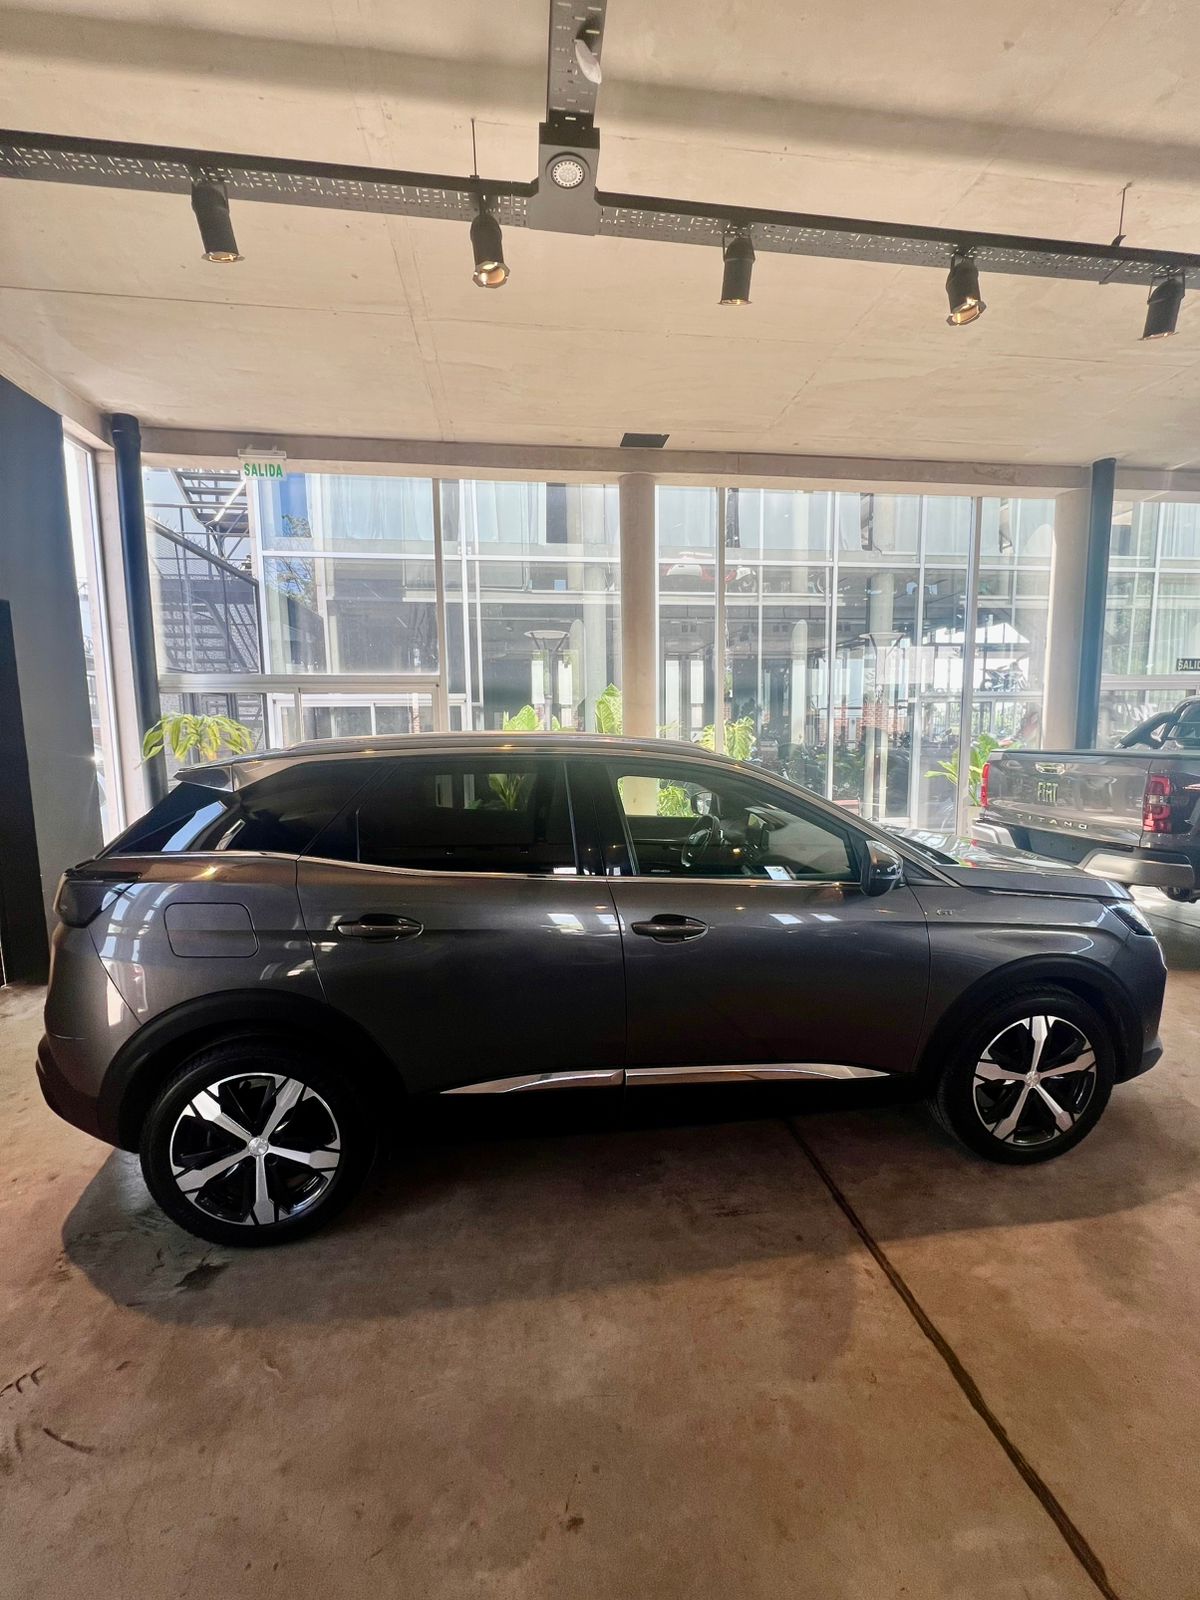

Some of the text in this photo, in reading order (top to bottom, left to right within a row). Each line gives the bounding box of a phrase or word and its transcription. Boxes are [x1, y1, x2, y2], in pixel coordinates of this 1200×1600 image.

[243, 463, 283, 477] SALIDA
[1037, 782, 1058, 803] FIAT
[1016, 813, 1088, 830] TITANO
